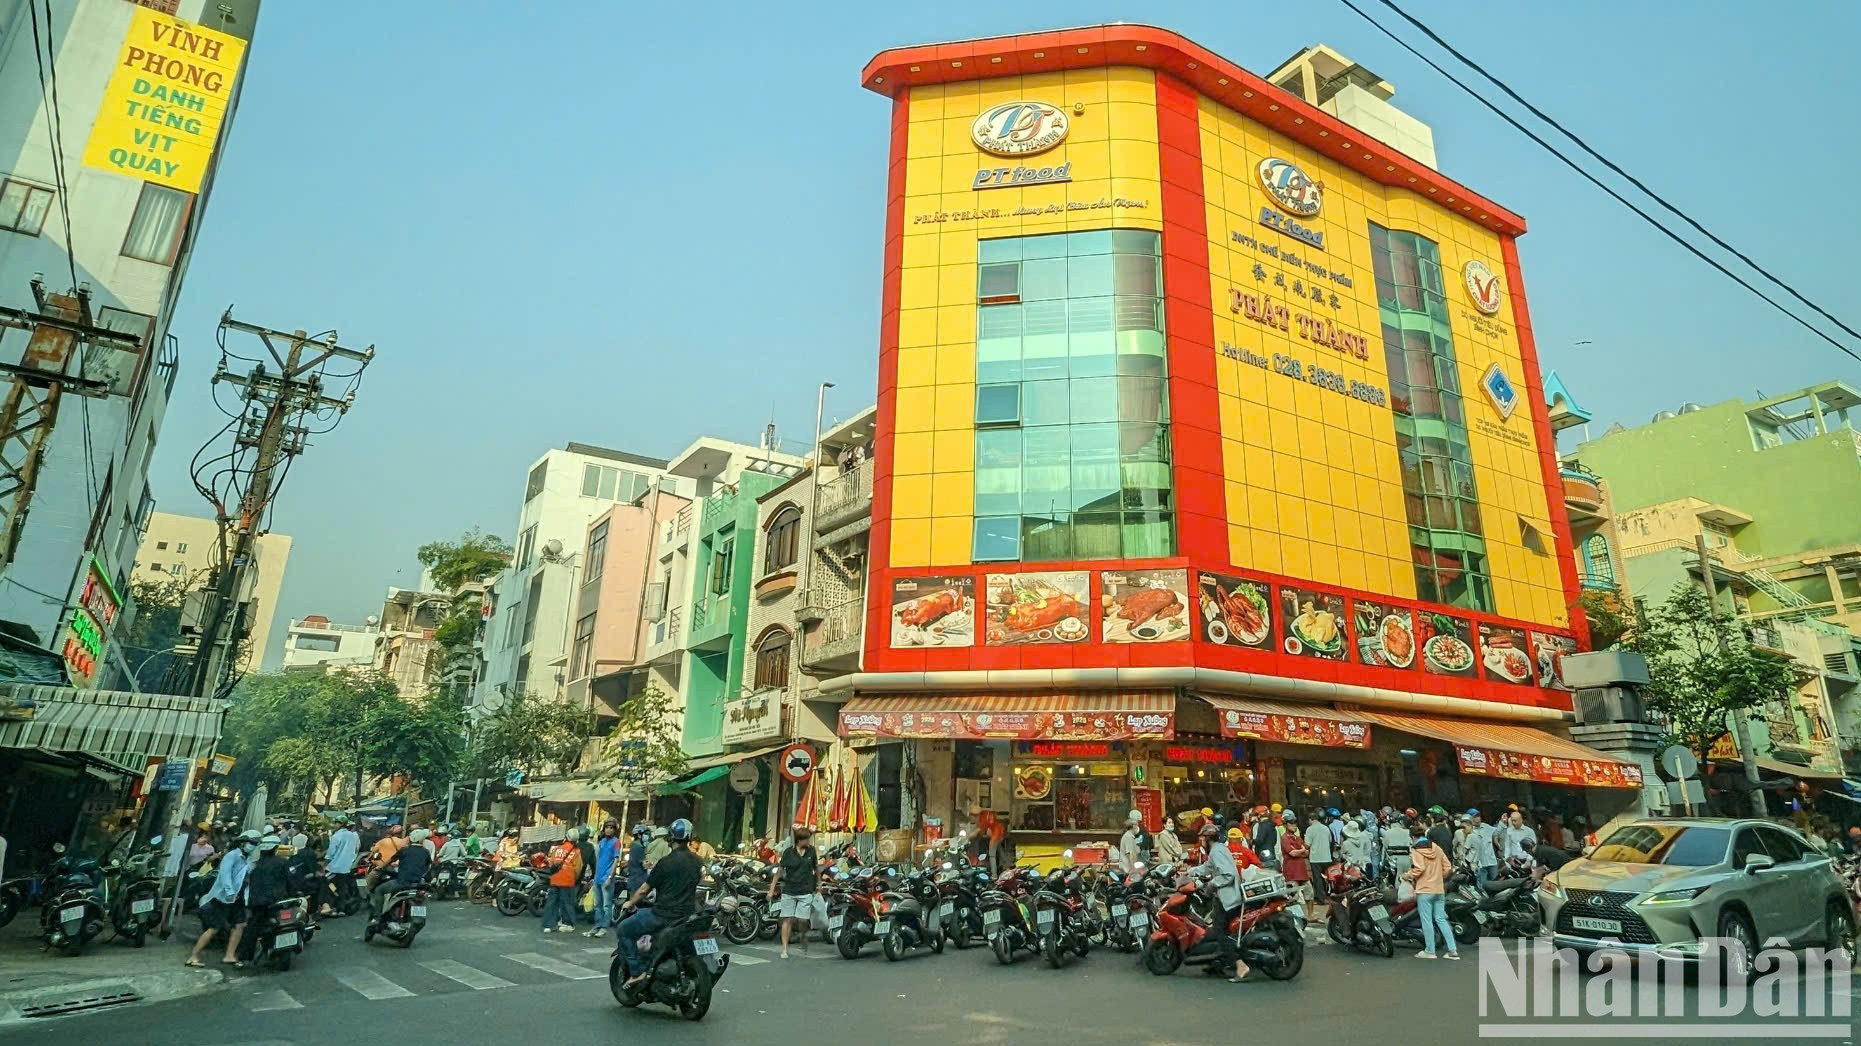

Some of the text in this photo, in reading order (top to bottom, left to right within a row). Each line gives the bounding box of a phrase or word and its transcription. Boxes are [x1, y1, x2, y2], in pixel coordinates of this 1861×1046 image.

[151, 21, 225, 61] VĨNH
[123, 46, 224, 93] PHONG
[132, 78, 206, 113] DANH
[126, 100, 202, 136] TIẾNG
[133, 128, 178, 153] VỊT
[109, 148, 180, 178] QUAY
[973, 161, 1072, 187] PT food
[913, 212, 949, 225] PHÁT
[1260, 206, 1324, 245] PT food
[1228, 286, 1370, 361] PHÁT THÀNH
